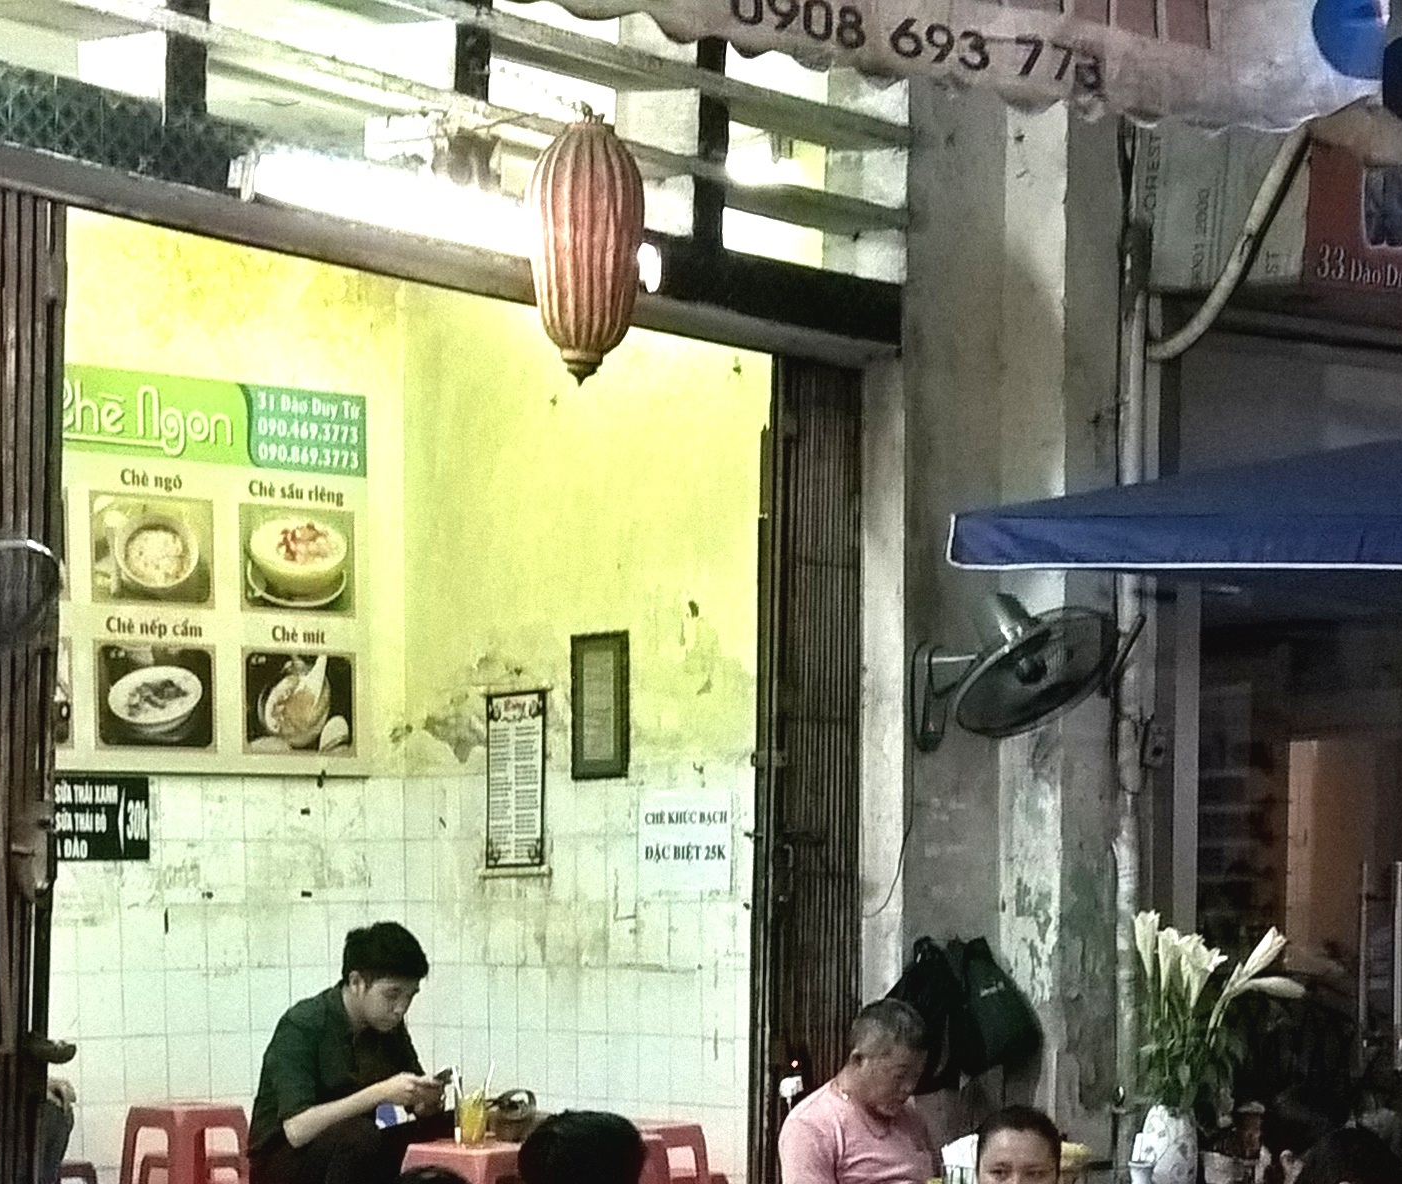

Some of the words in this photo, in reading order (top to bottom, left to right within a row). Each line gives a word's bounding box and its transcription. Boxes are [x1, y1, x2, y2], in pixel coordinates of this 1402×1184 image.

[889, 17, 991, 71] 693
[1317, 244, 1345, 279] 33
[257, 391, 275, 412] 31
[311, 397, 338, 420] Duy
[137, 385, 233, 457] Ngon
[257, 416, 359, 444] 090.469.3773
[257, 441, 359, 469] 090.869.3773
[120, 467, 149, 487] Chè
[248, 480, 276, 498] Chè
[105, 615, 135, 635] Chè
[271, 625, 299, 643] Chè
[699, 810, 728, 827] BẠCH
[673, 841, 702, 865] BIỆT
[704, 844, 727, 861] 25K
